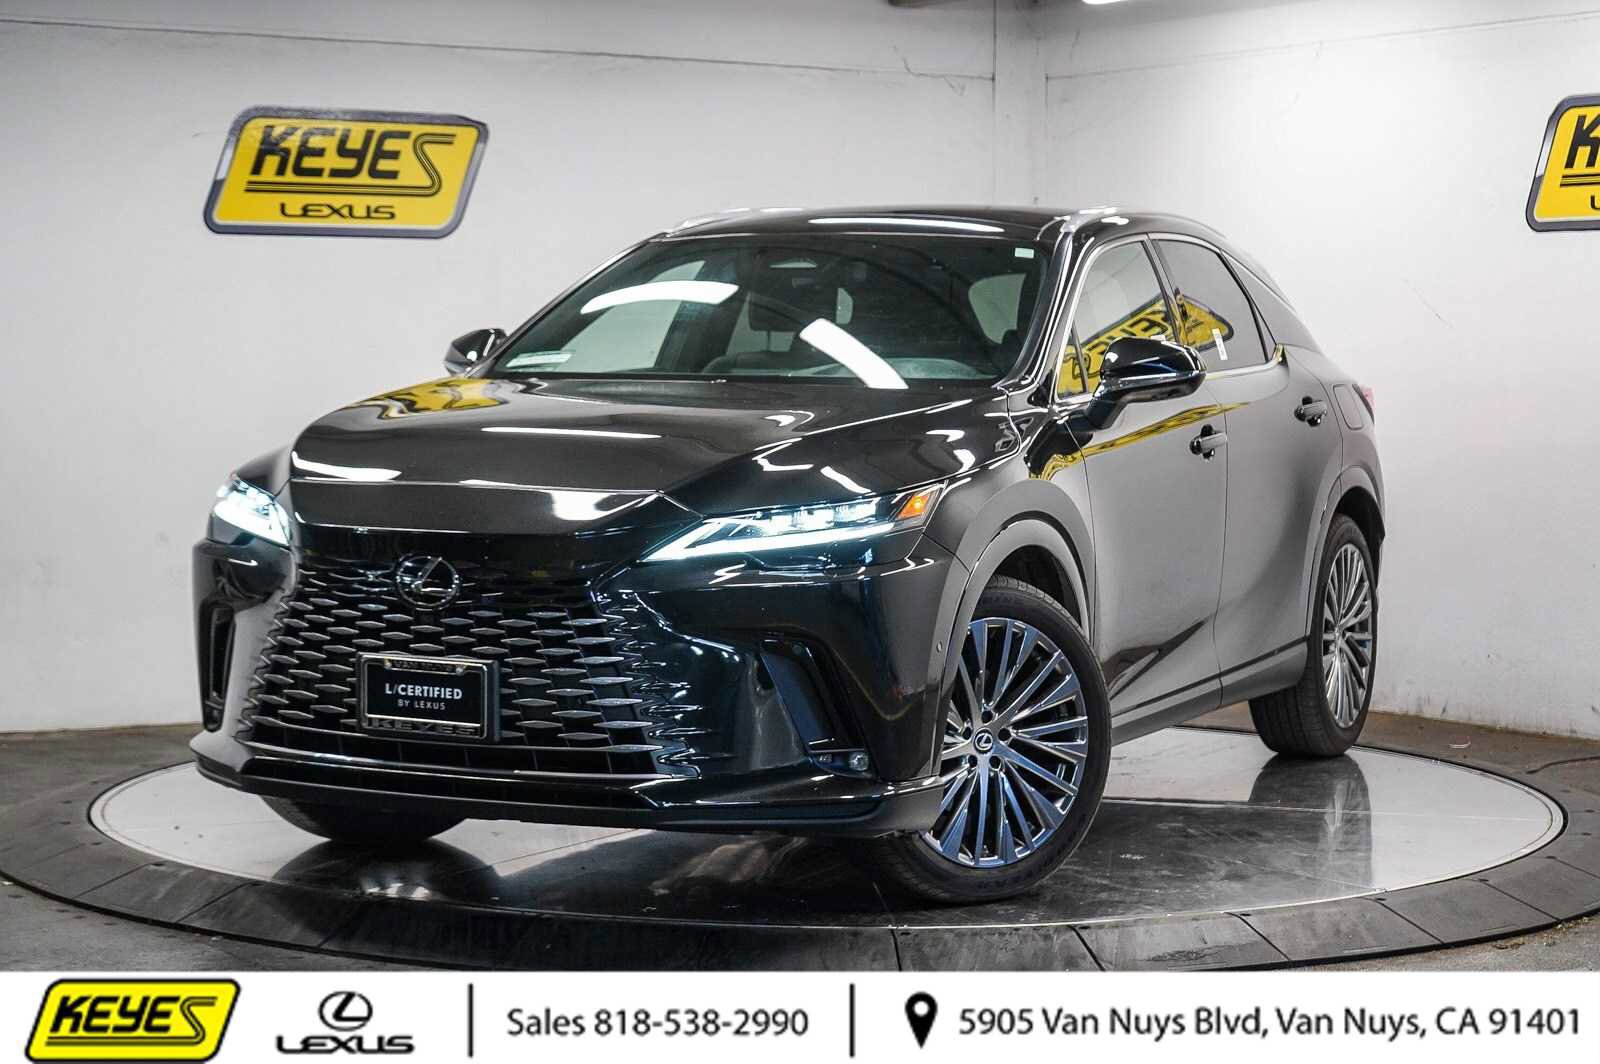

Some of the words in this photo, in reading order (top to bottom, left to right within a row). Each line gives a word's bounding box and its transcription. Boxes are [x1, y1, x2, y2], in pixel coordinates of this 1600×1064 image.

[245, 124, 457, 197] KEYES
[279, 202, 396, 220] LEXUS
[384, 682, 463, 700] L/CERTIFIED
[397, 699, 410, 708] BY
[414, 700, 446, 711] LEXUS
